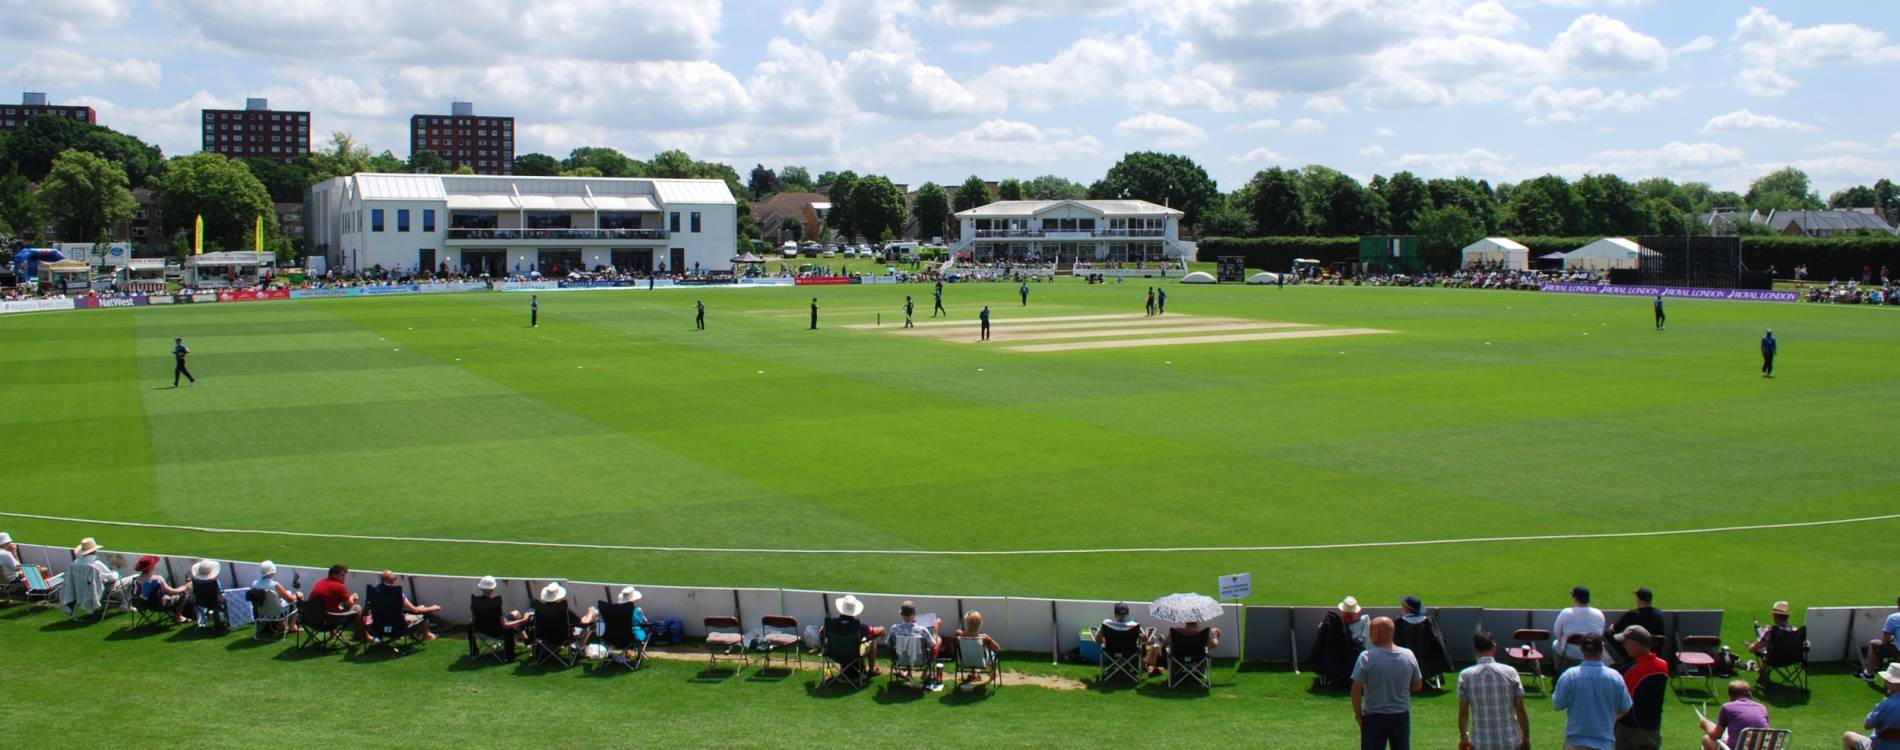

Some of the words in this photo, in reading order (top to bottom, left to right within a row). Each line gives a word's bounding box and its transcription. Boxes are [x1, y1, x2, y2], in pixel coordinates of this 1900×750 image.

[1568, 285, 1598, 293] LONDON
[1605, 286, 1627, 294] ROYAL
[1628, 287, 1659, 295] LONDON
[1667, 288, 1690, 296] ROYAL
[1691, 289, 1725, 298] LONDON
[1733, 291, 1759, 299] ROYAL
[1760, 292, 1796, 300] LONDON
[99, 297, 134, 307] NatWest
